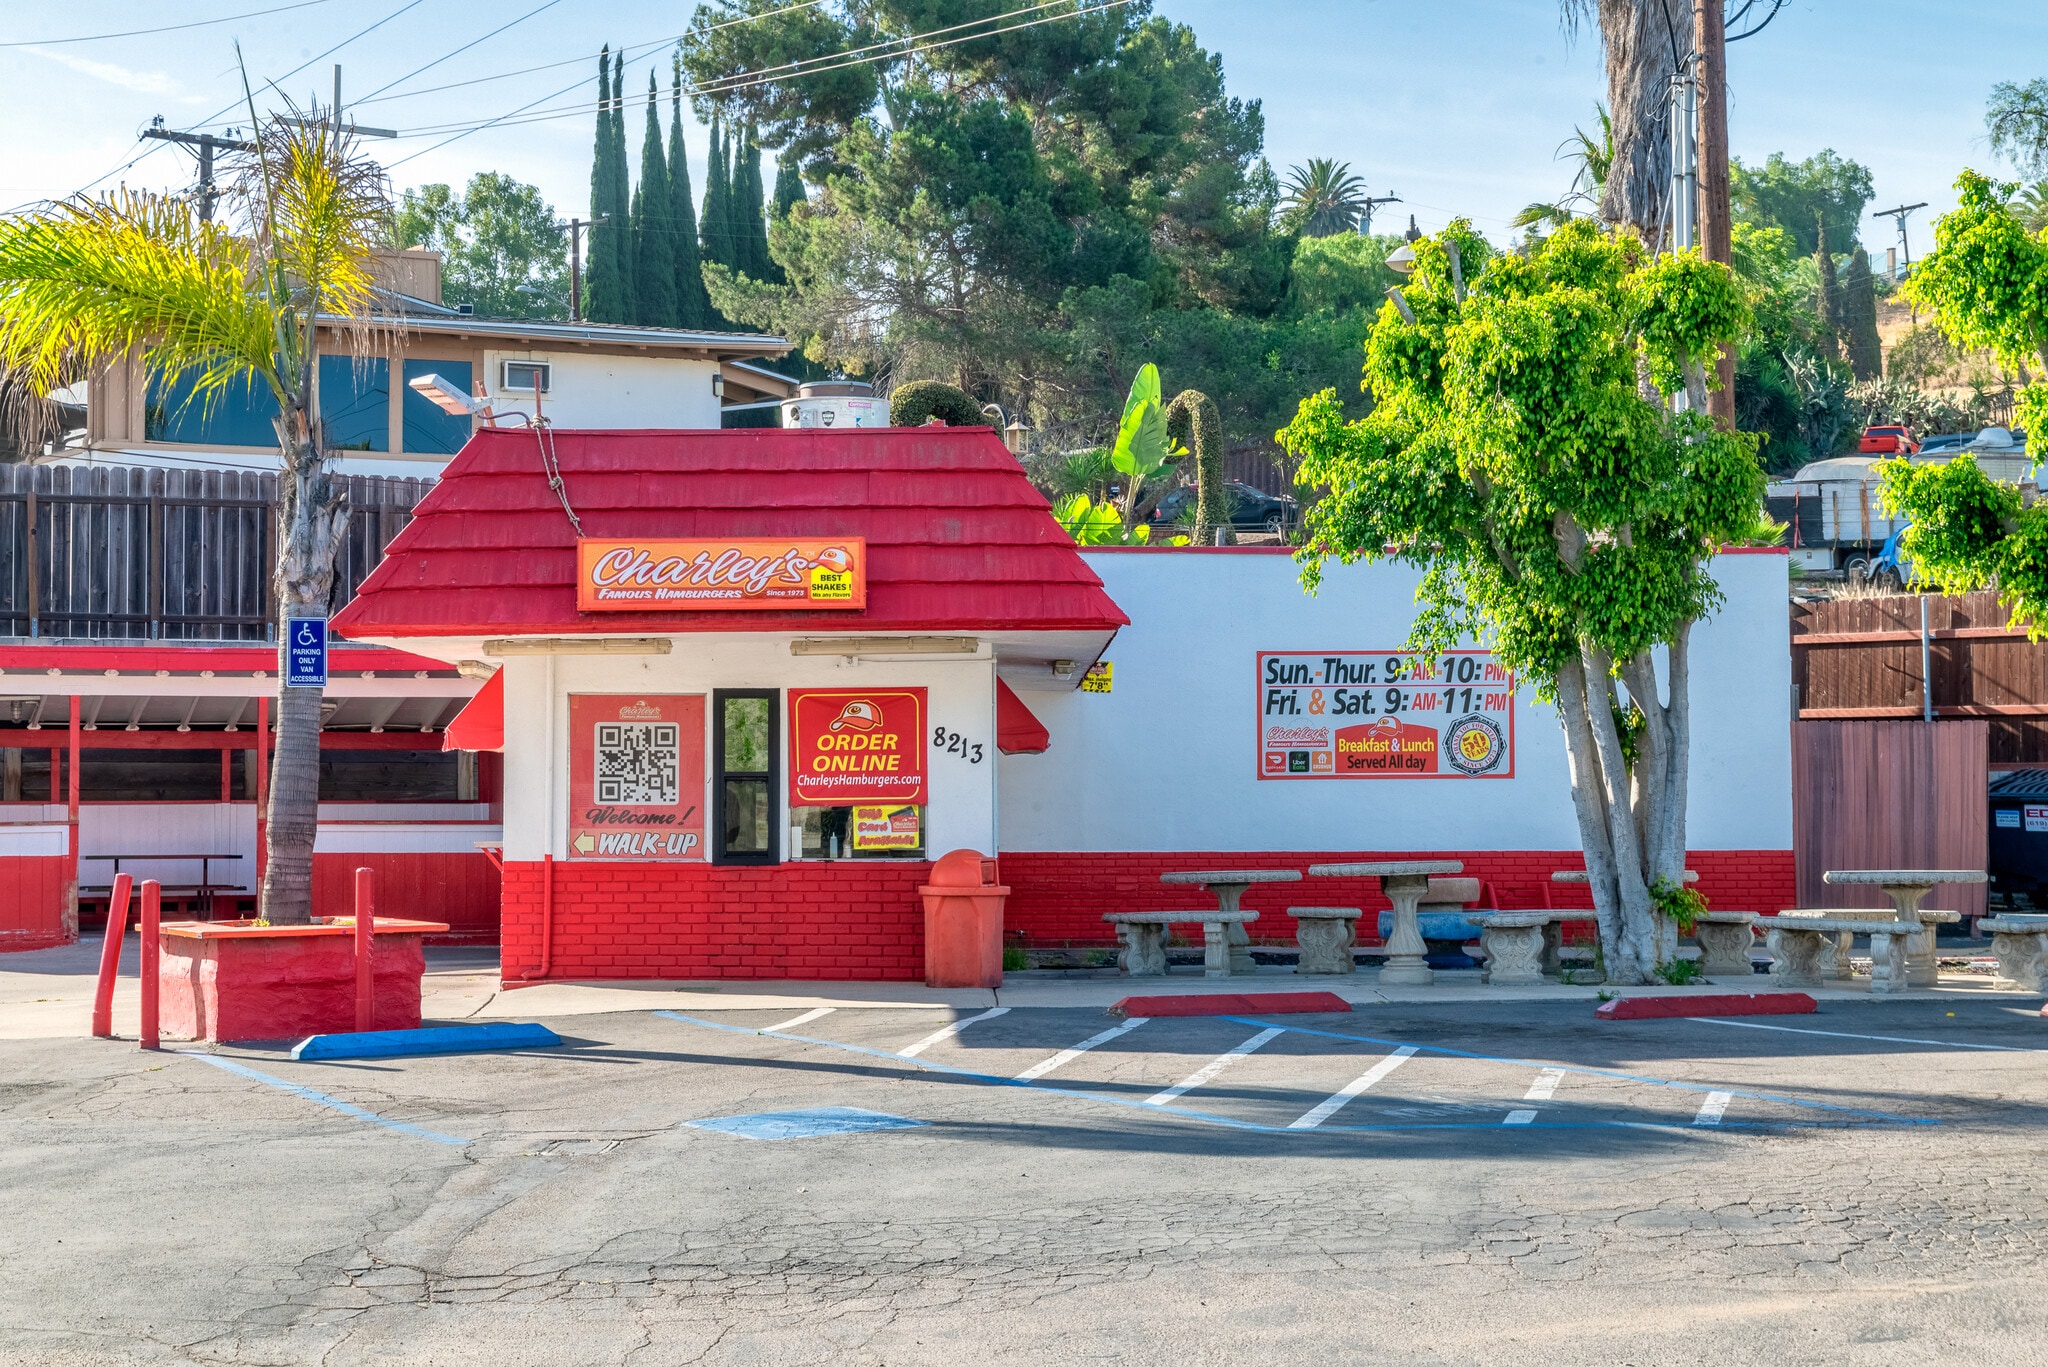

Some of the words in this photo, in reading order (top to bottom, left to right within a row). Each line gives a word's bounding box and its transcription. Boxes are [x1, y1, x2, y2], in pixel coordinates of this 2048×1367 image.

[592, 547, 809, 595] Charley's
[820, 574, 843, 582] BEST
[811, 583, 847, 591] SHAKES
[1265, 689, 1302, 716] Fri.
[1308, 688, 1326, 716] &
[1331, 688, 1376, 716] Sat.
[816, 733, 899, 751] ORDER
[1266, 726, 1330, 742] Charley's
[1462, 732, 1487, 753] 50
[933, 726, 983, 764] 8213
[1338, 737, 1390, 753] Breakfast
[1391, 737, 1400, 752] &
[1401, 737, 1435, 752] Lunch
[1467, 746, 1489, 759] YEARS
[812, 754, 901, 772] ONLINE
[1347, 754, 1387, 769] Served
[1388, 754, 1404, 769] All
[1405, 754, 1427, 772] day
[797, 773, 921, 788] CharleysHamburgers.com
[585, 806, 676, 825] Welcome
[858, 822, 888, 832] Card
[598, 833, 699, 856] WALK-UP
